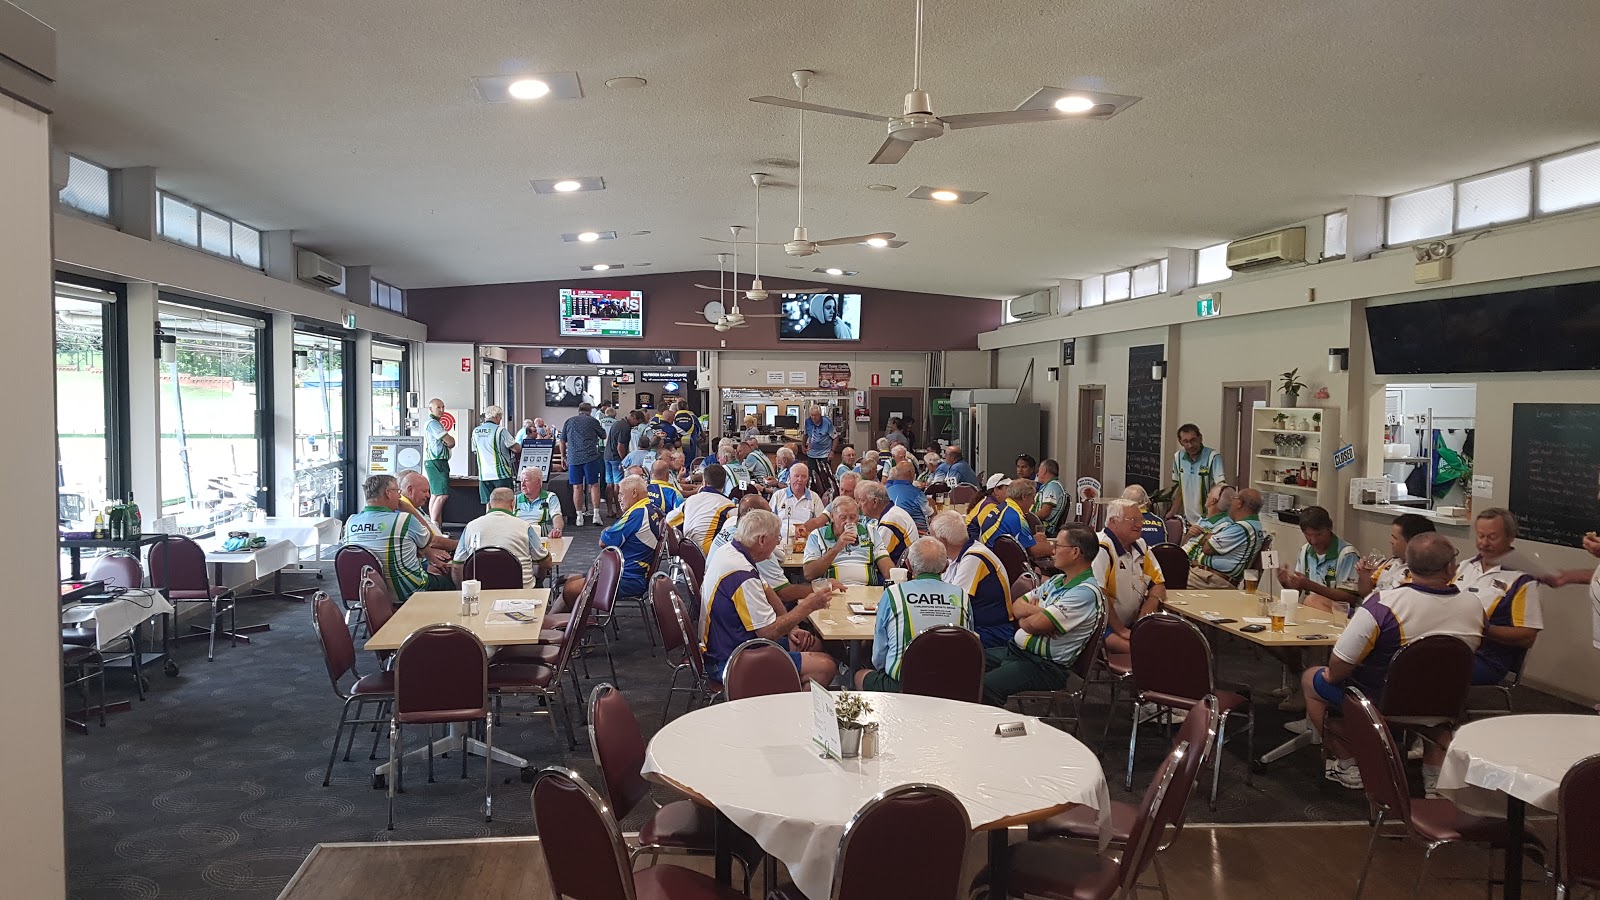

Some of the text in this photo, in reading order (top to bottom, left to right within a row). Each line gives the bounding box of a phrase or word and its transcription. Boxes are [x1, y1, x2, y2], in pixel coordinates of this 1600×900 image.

[1416, 415, 1426, 423] 15
[1335, 448, 1353, 466] CLOSED
[948, 478, 955, 486] 12
[351, 523, 378, 533] CARL
[1267, 553, 1273, 566] 1
[906, 593, 950, 605] CARL
